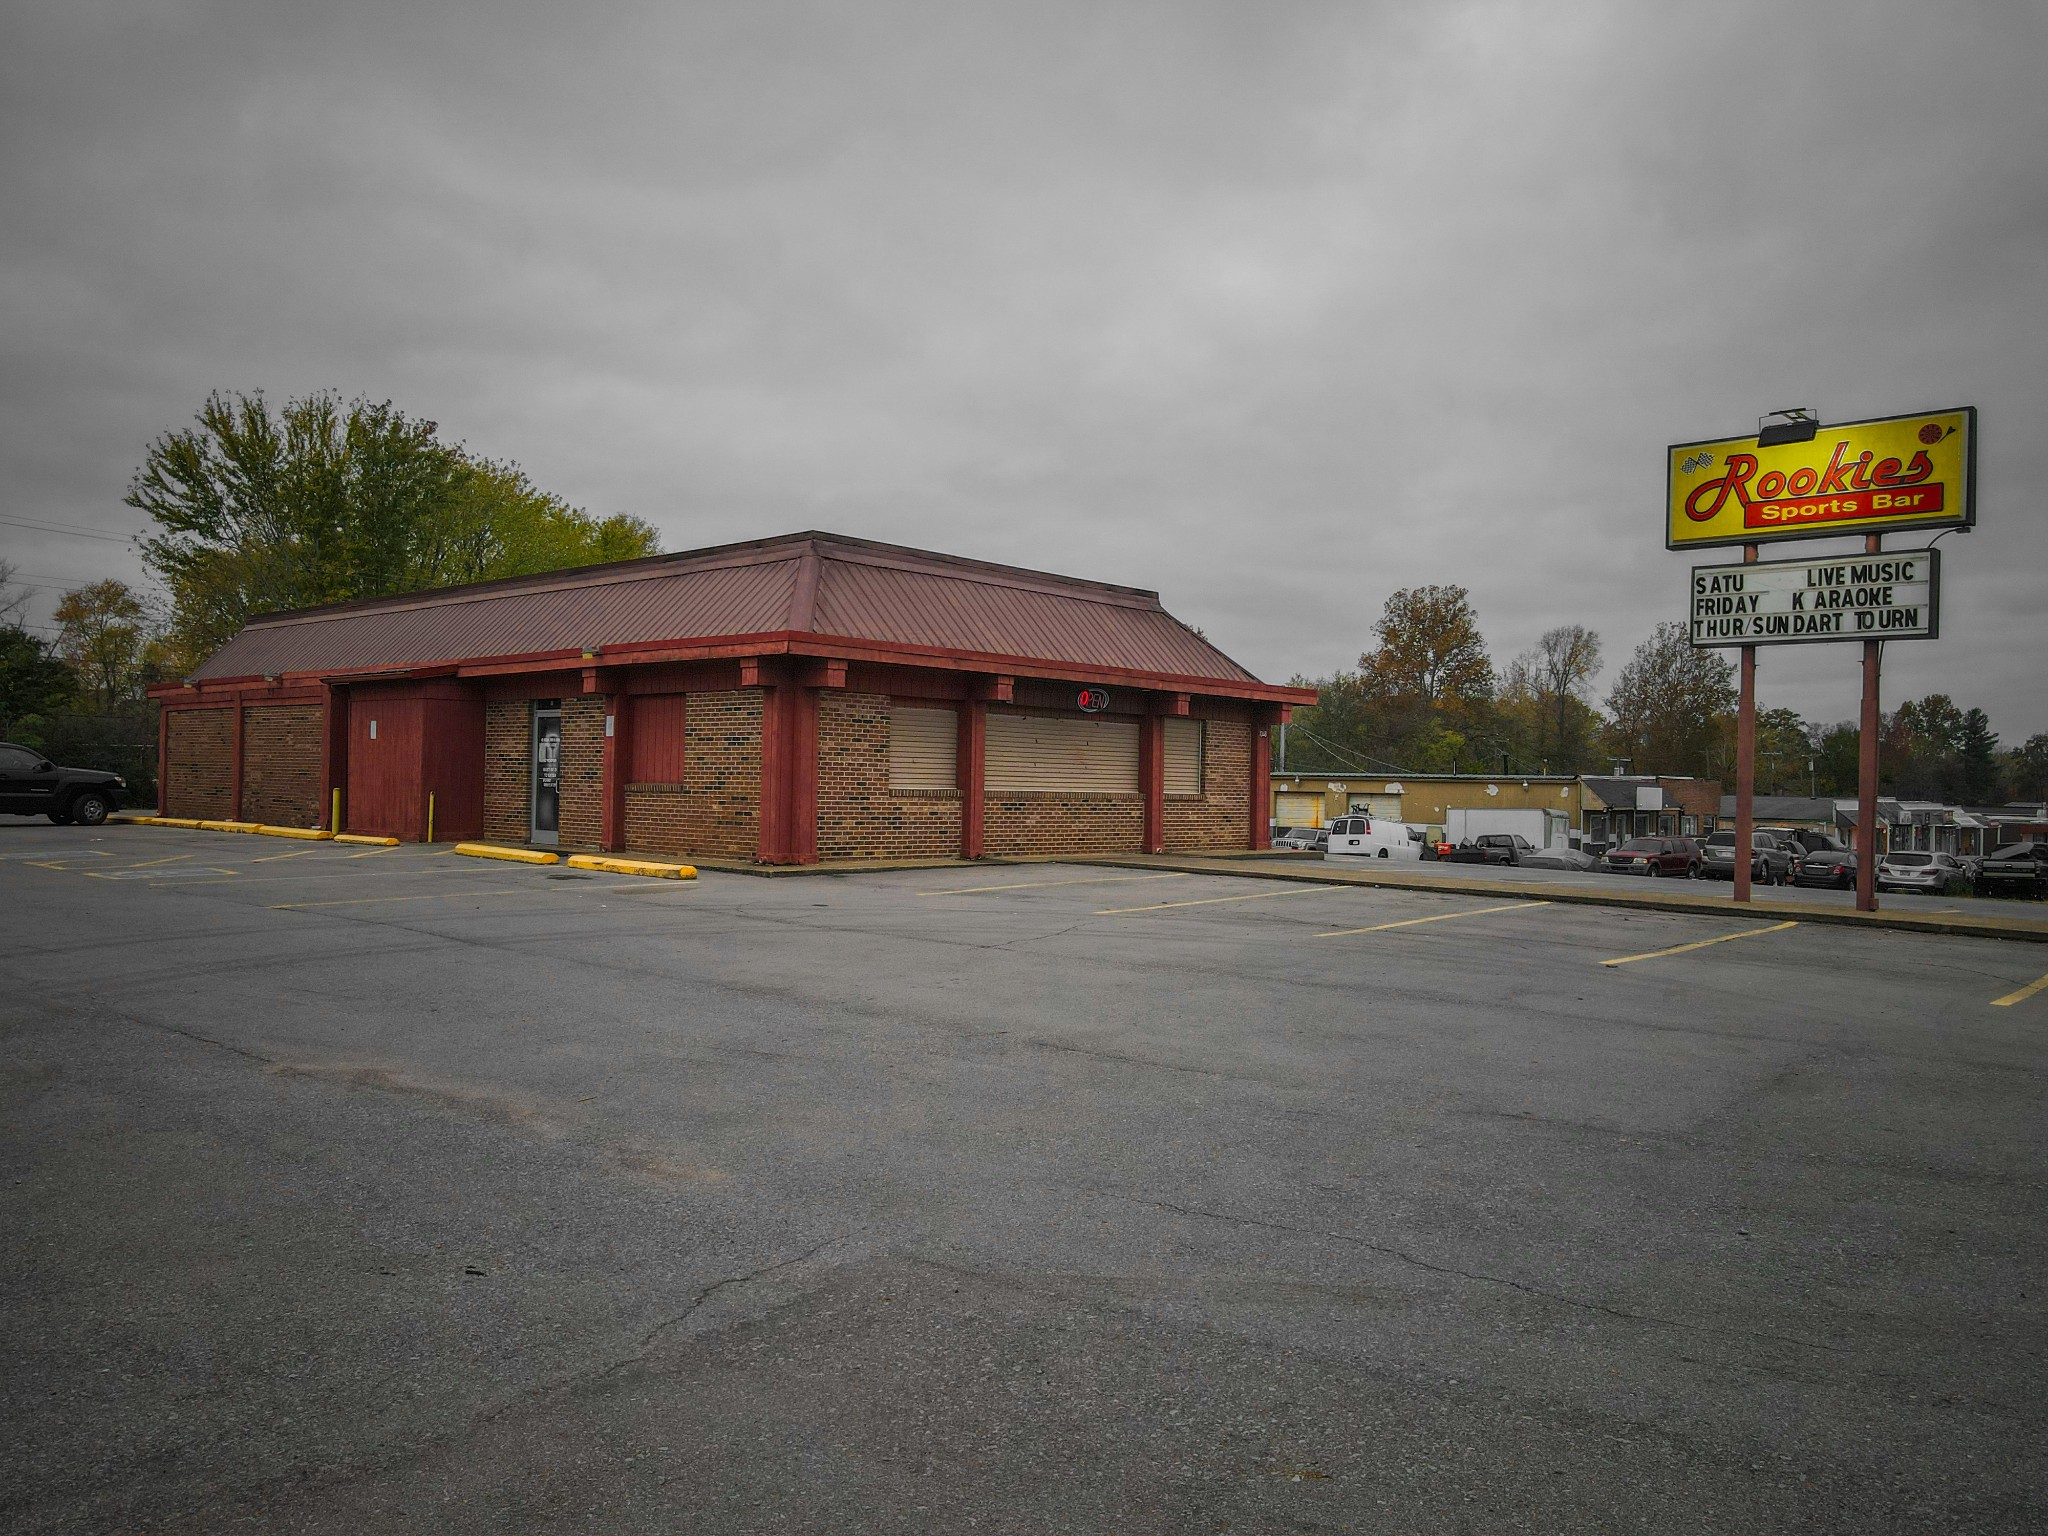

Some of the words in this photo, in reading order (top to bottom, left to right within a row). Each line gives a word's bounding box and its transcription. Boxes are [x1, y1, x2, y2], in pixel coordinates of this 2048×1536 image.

[1761, 499, 1858, 520] Sports
[1872, 493, 1925, 510] Bar
[1806, 566, 1846, 587] LIVE
[1850, 561, 1914, 584] MUSIC
[1696, 595, 1759, 616] FRIDAY
[1080, 690, 1105, 708] OPEN
